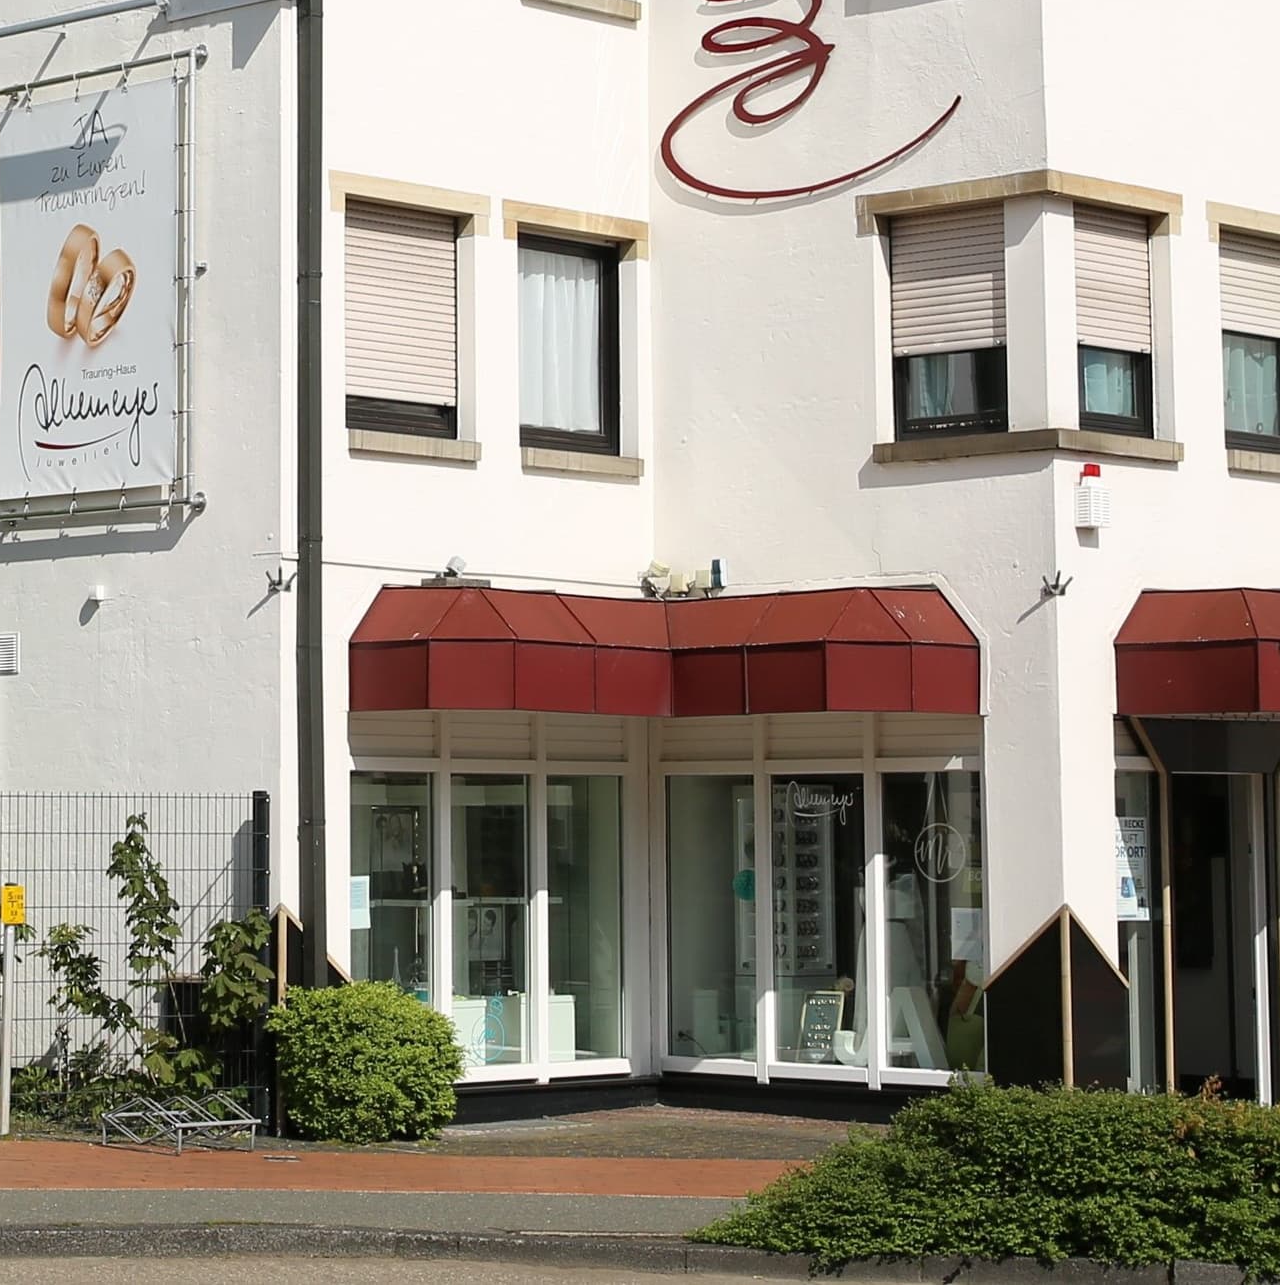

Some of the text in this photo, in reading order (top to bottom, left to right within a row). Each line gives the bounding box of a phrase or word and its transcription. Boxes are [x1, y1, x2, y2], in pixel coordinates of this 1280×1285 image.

[69, 108, 109, 150] JA
[50, 151, 127, 183] zu Euren
[34, 169, 146, 212] Traumringen!
[81, 363, 137, 381] Trauring-Haus
